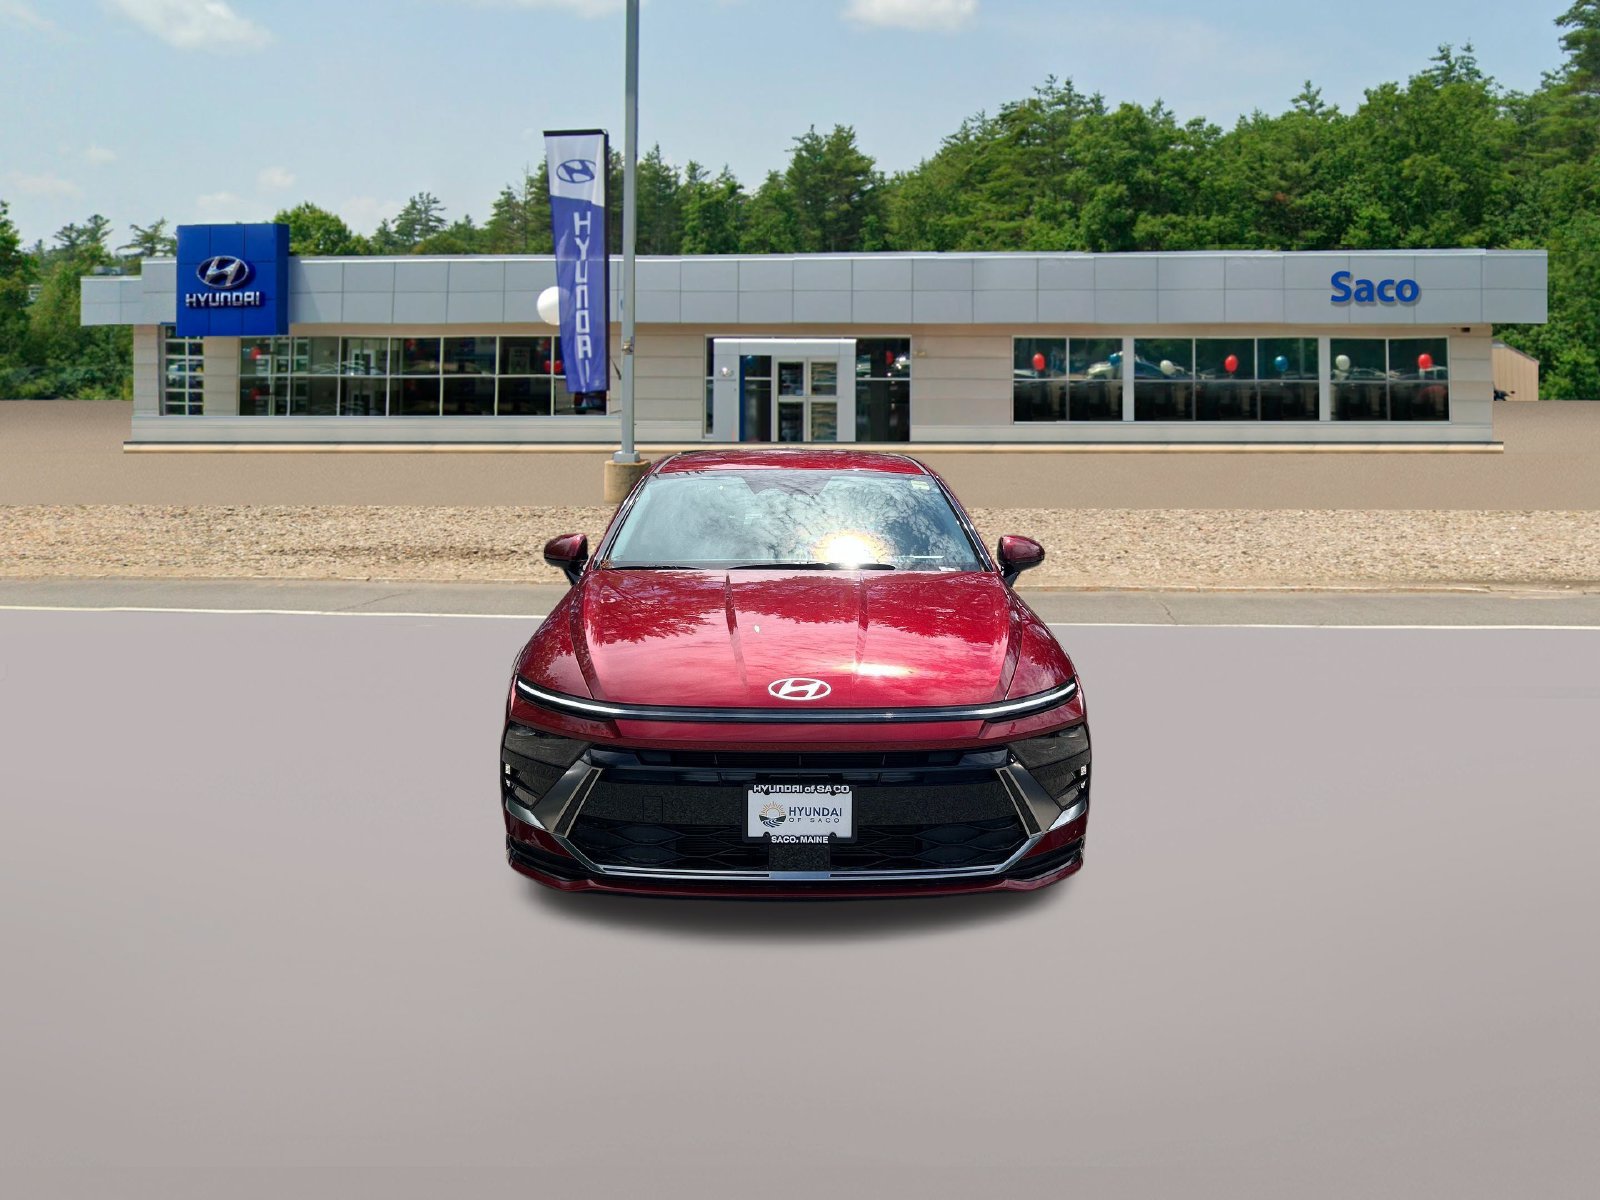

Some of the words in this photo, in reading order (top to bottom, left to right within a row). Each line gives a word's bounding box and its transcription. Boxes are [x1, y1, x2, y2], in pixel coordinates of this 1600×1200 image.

[1330, 270, 1419, 302] Saco
[186, 291, 260, 307] HYUNDAI
[573, 211, 592, 383] HYUNDAI
[753, 784, 803, 793] HYUNDAI
[805, 785, 816, 793] of
[817, 784, 850, 794] SACO
[789, 806, 842, 817] HYUNDAI
[800, 836, 829, 844] MAINE
